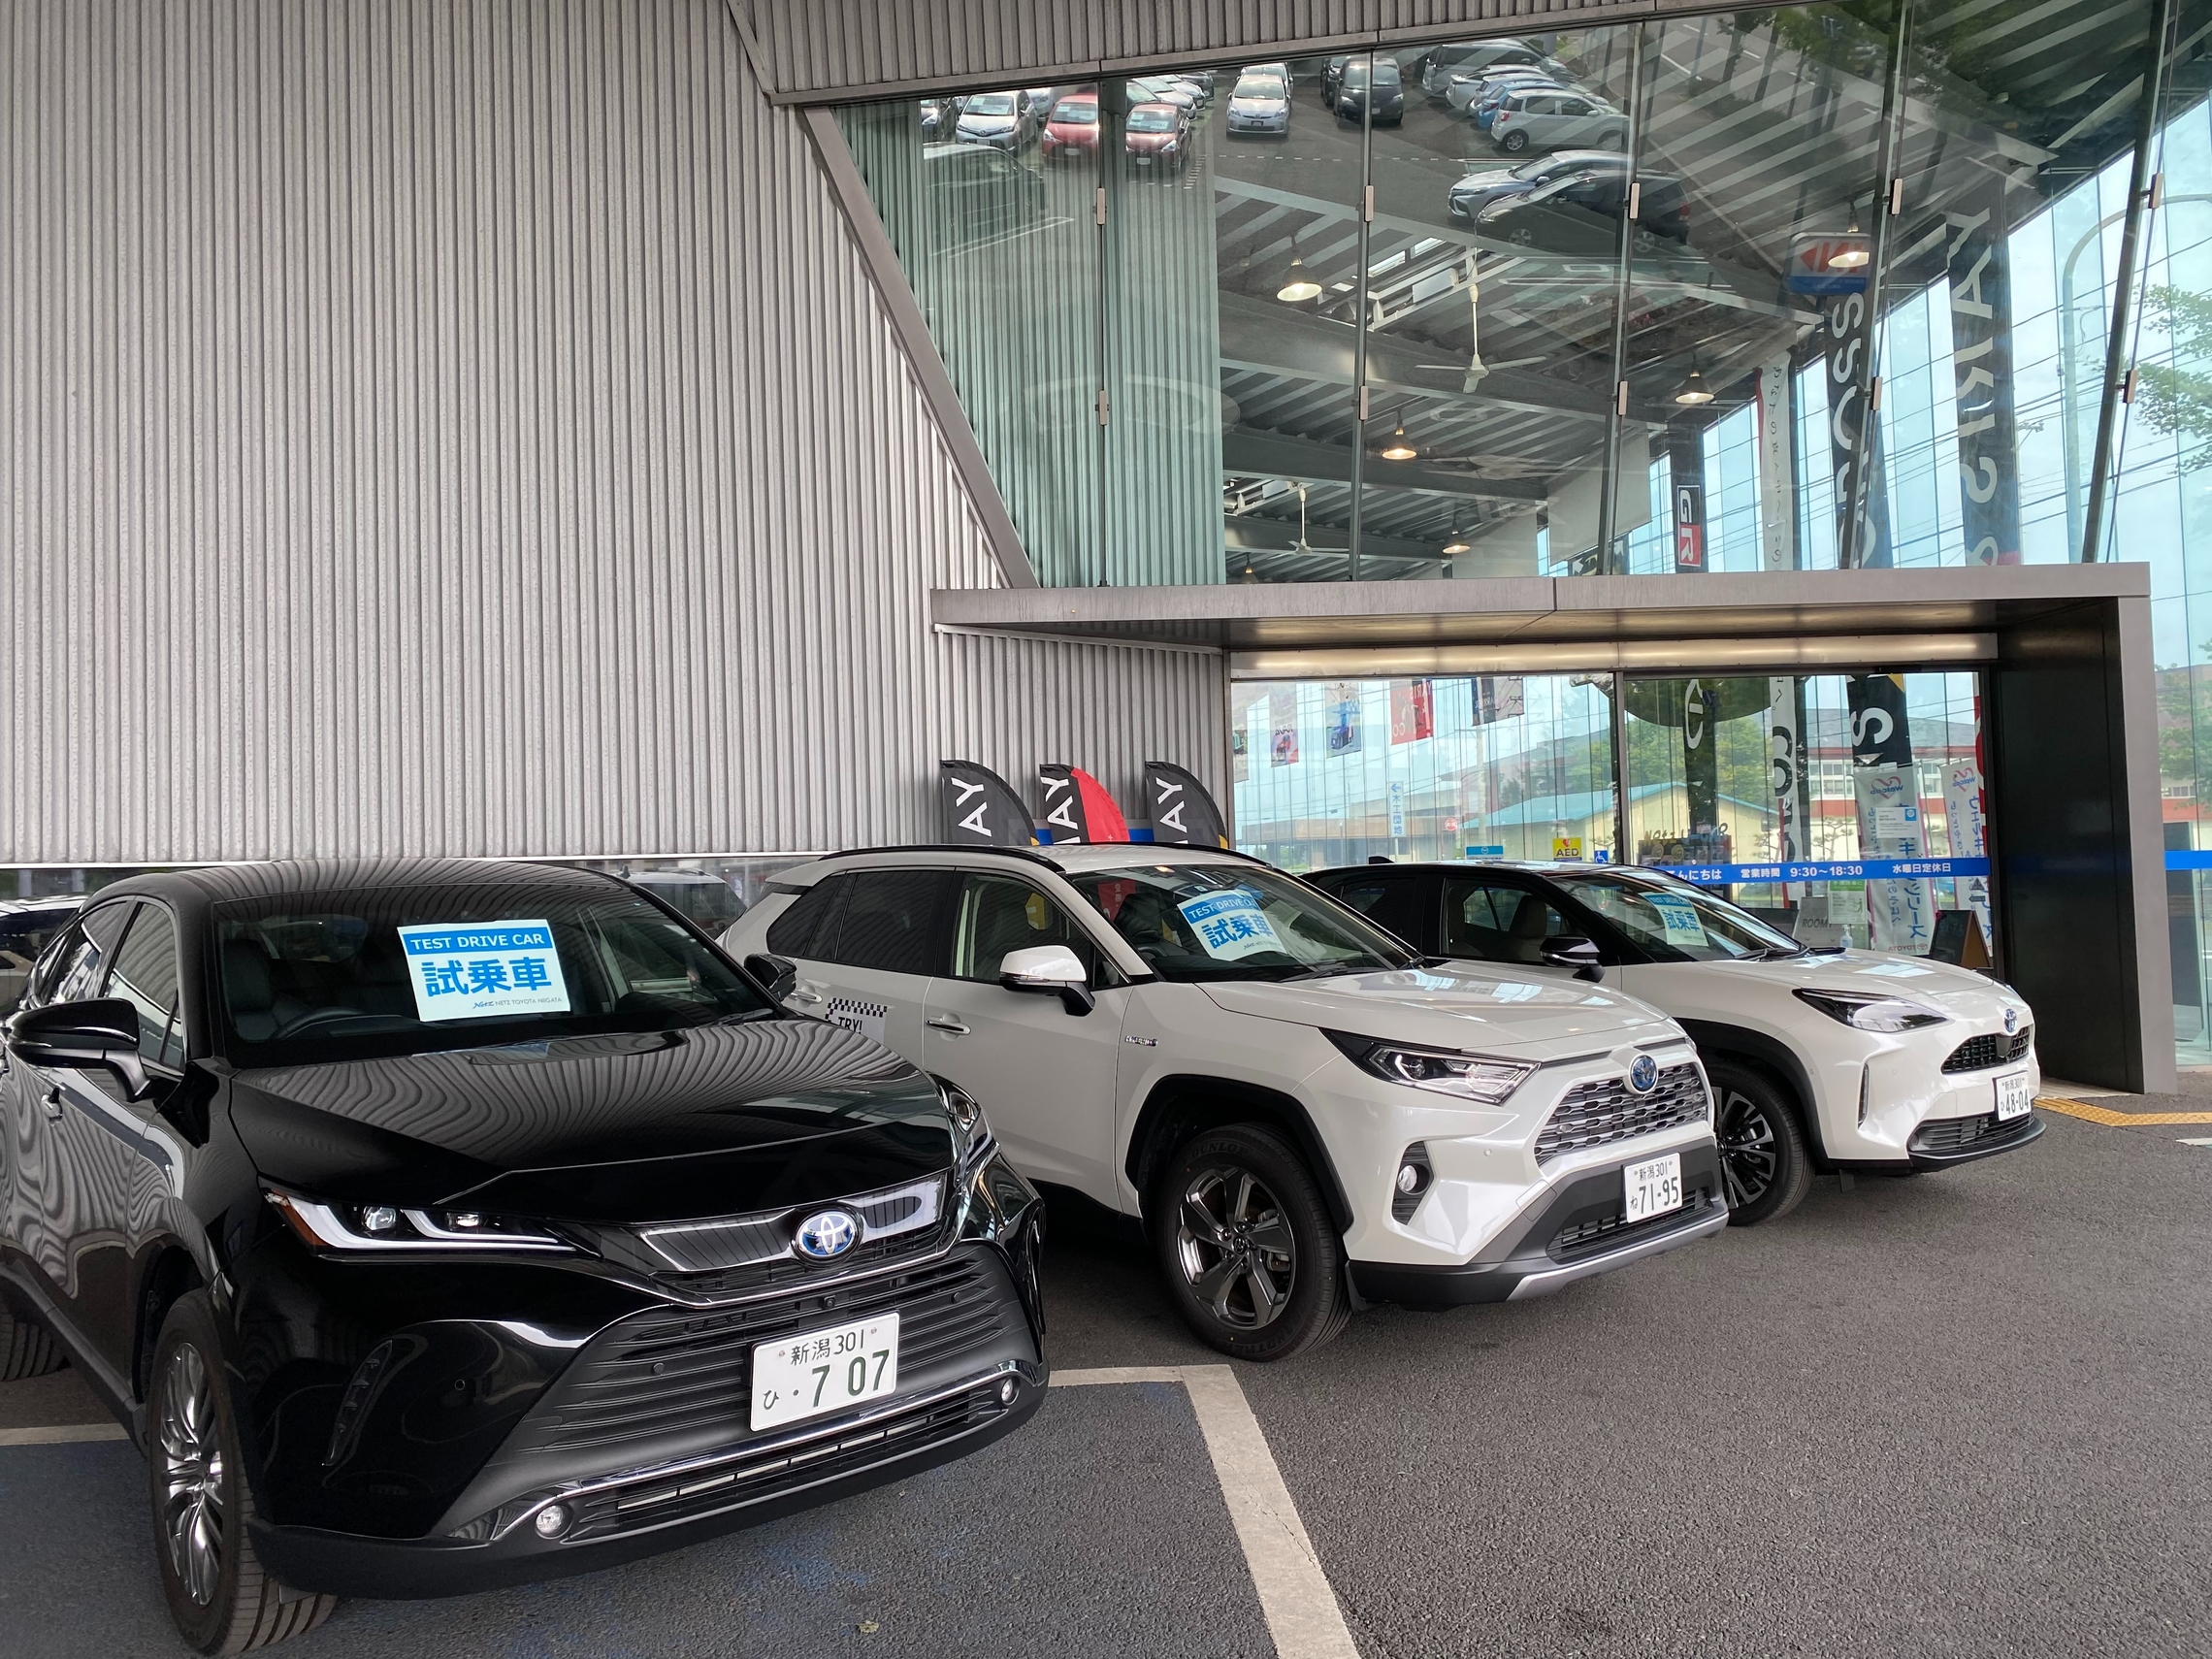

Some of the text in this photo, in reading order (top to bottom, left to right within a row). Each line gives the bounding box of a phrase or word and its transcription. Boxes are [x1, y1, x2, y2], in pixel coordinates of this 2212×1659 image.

[1556, 848, 1579, 857] AED
[1667, 868, 1722, 880] んにちは
[1740, 867, 1780, 878] 営業時間
[1892, 862, 1951, 874] 水曜日定休日
[1188, 904, 1216, 919] TEST
[1216, 898, 1244, 910] DRIVE
[410, 932, 545, 951] TEST DRIVE CAR
[1202, 914, 1273, 949] 試乗車
[421, 957, 552, 997] 試乗車
[838, 1016, 862, 1034] TRY!
[2006, 1089, 2029, 1115] 48-04
[1639, 1176, 1679, 1215] 71-95
[763, 1389, 779, 1411] ひ
